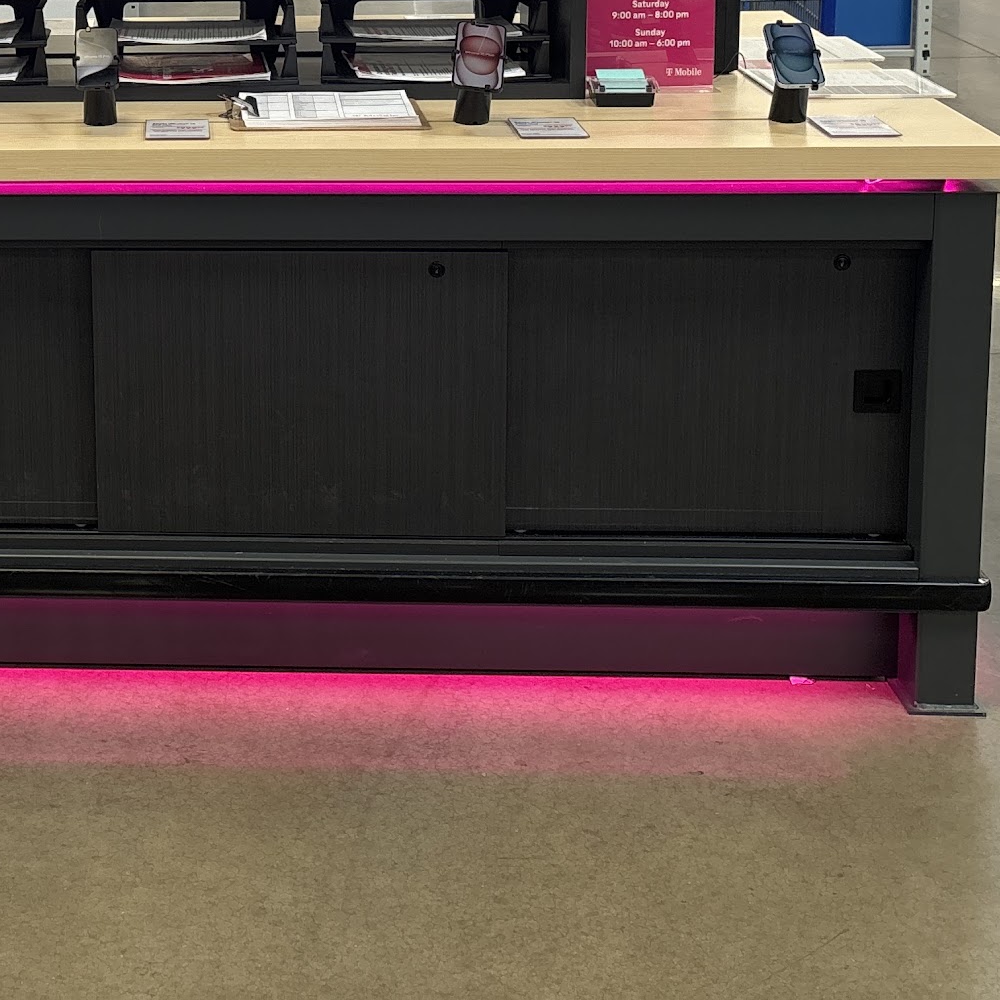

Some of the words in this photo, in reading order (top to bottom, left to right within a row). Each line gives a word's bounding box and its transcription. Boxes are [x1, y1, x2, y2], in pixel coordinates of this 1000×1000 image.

[632, 0, 669, 9] Saturday
[611, 10, 631, 19] 9:00
[654, 10, 674, 18] 8:00
[675, 11, 689, 19] pm
[634, 28, 665, 37] Sunday
[609, 39, 633, 47] 10:00
[656, 38, 676, 47] 6:00
[676, 40, 690, 48] pm
[674, 67, 702, 76] Mobile
